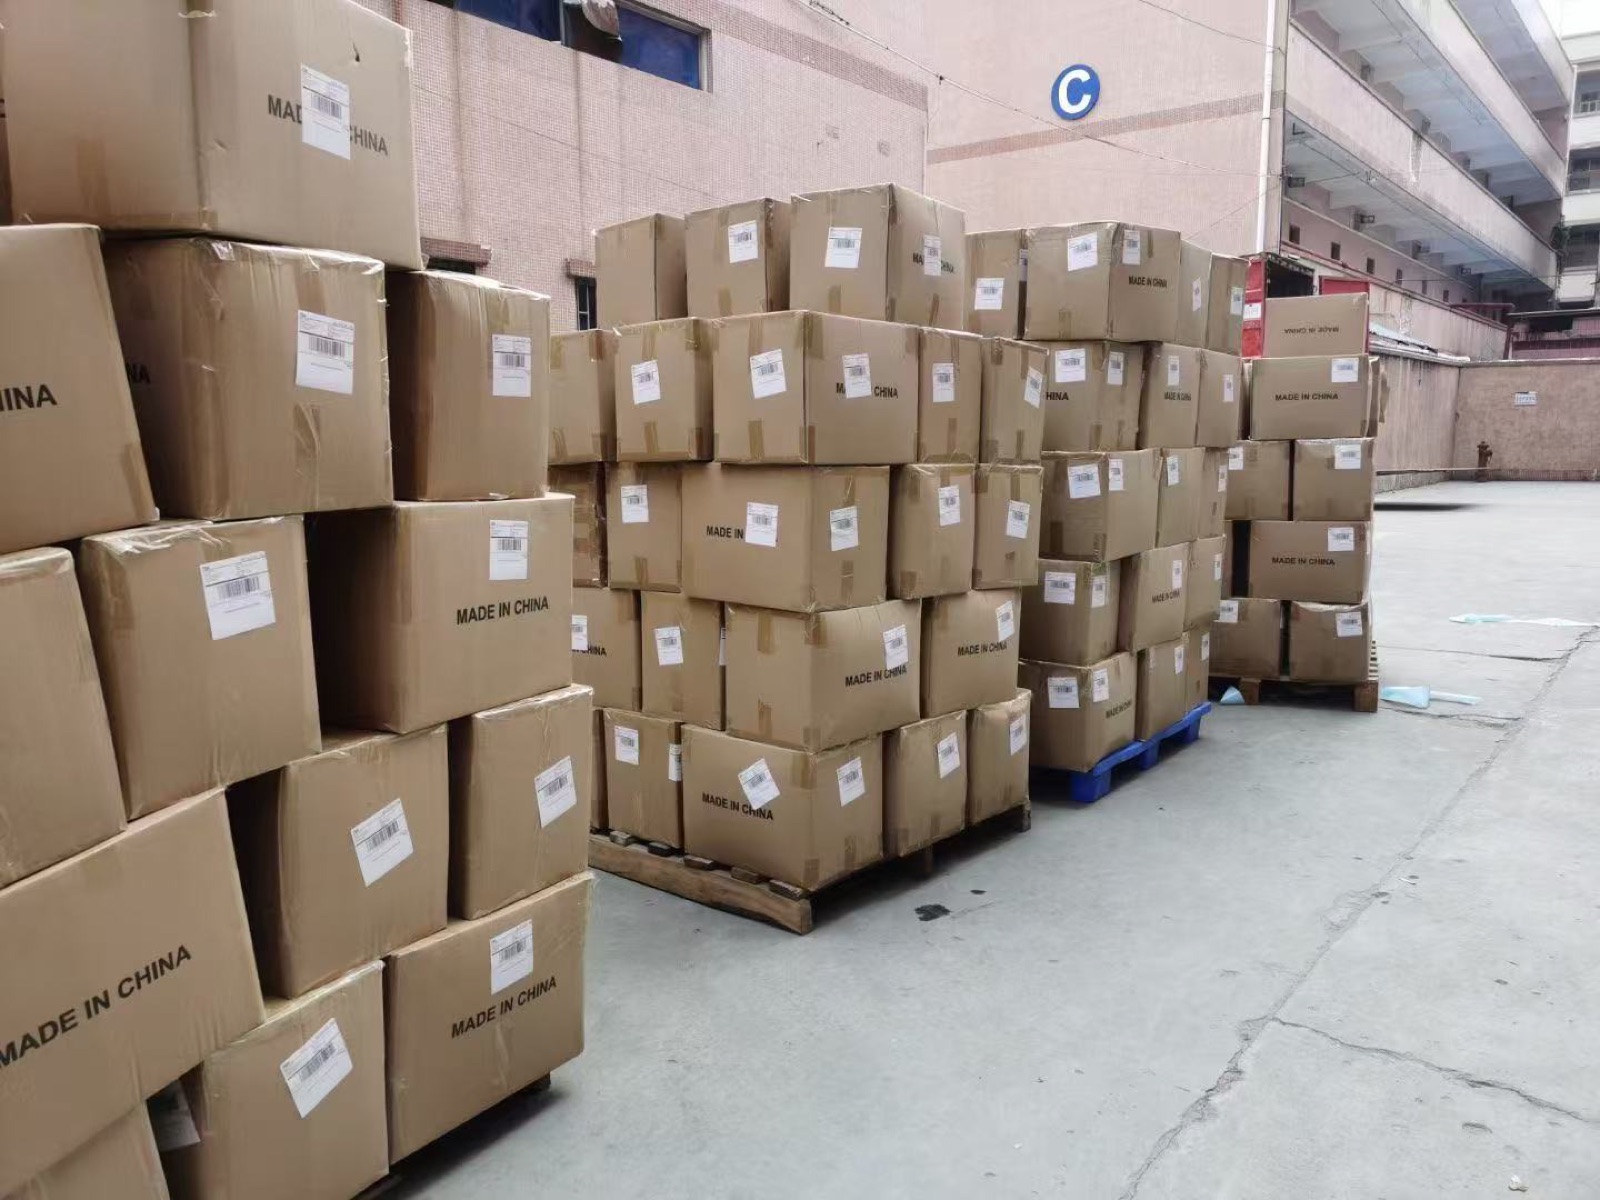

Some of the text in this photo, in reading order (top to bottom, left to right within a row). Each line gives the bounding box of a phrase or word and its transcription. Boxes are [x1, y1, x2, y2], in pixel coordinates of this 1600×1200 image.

[1058, 69, 1092, 114] C
[873, 386, 899, 399] CHINA
[1045, 391, 1069, 401] HINA
[1275, 392, 1339, 402] MADE IN CHINA
[706, 525, 744, 540] MADE IN
[1271, 557, 1336, 566] MADE IN CHINA
[457, 595, 549, 625] MADE IN CHINA
[957, 644, 980, 657] MADE
[845, 672, 872, 687] MADE
[873, 670, 882, 681] IN
[702, 792, 728, 809] MADE
[730, 801, 740, 812] IN
[0, 944, 191, 1070] MADE IN CHINA
[451, 975, 558, 1039] MADE IN CHINA
